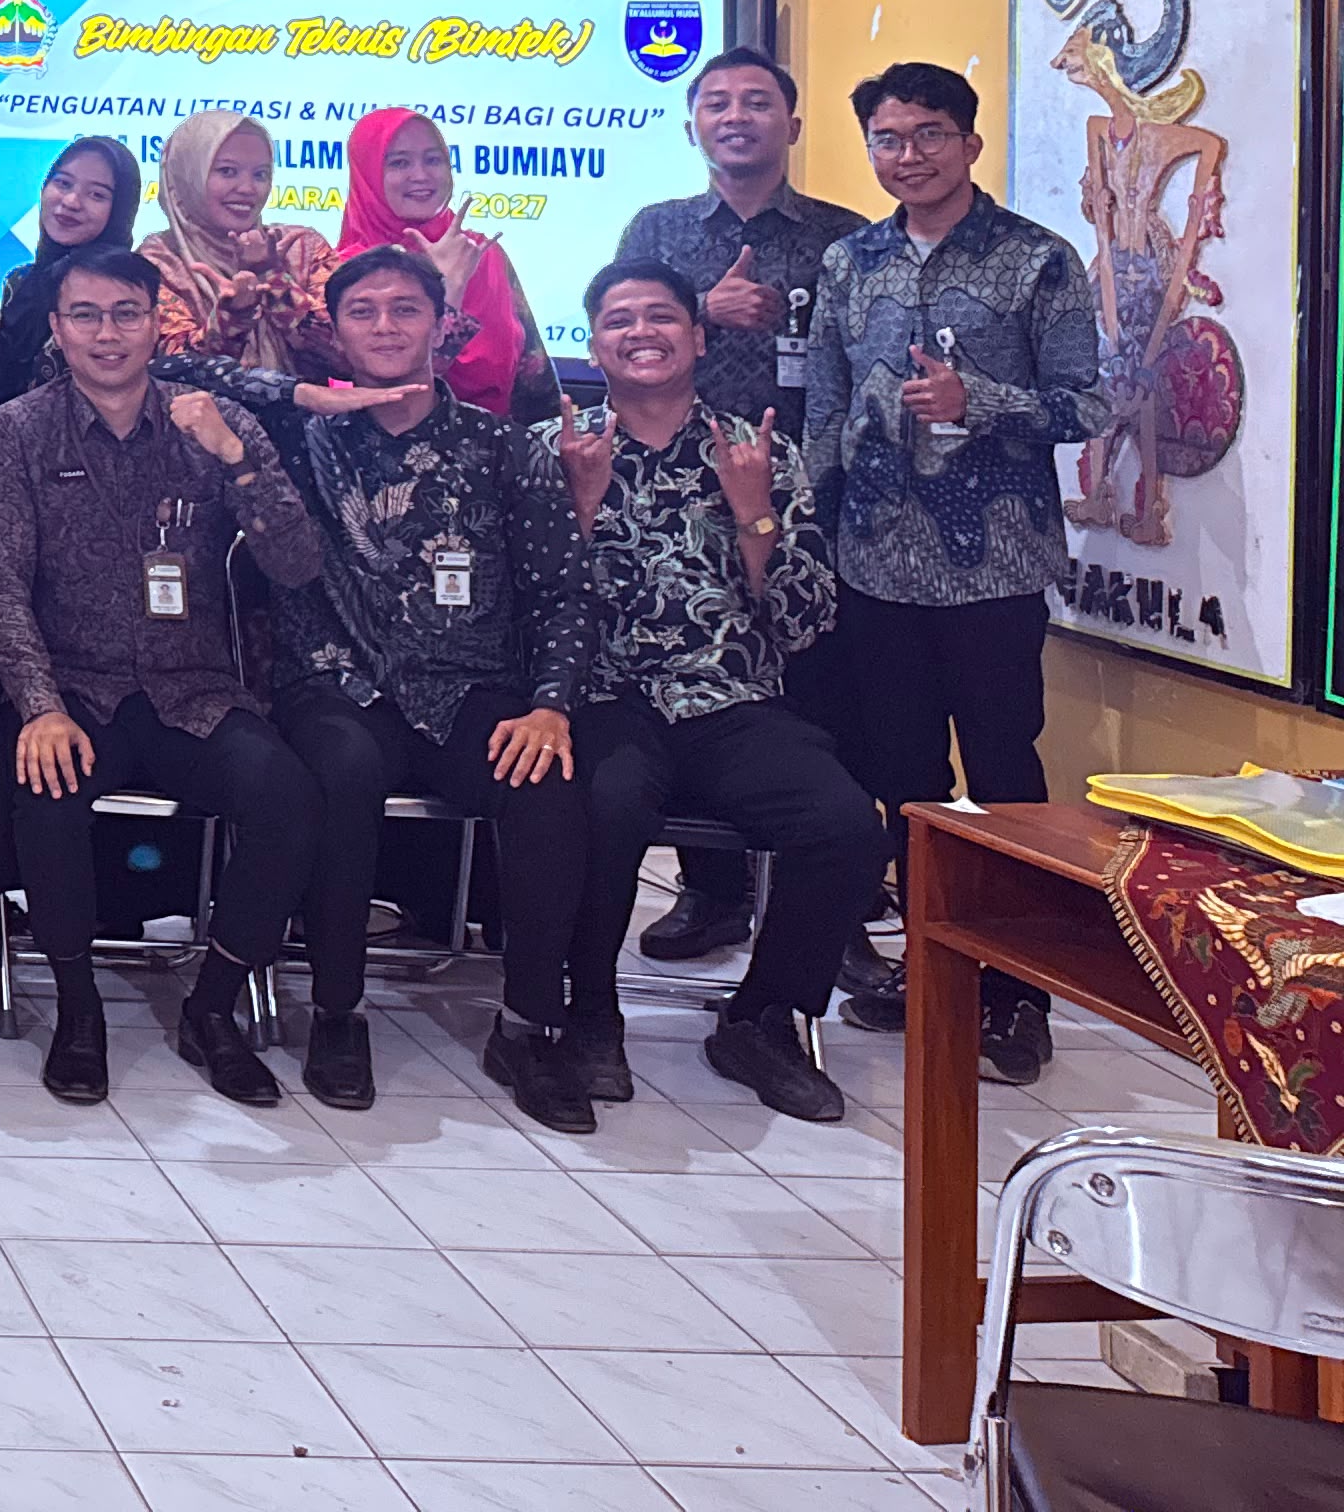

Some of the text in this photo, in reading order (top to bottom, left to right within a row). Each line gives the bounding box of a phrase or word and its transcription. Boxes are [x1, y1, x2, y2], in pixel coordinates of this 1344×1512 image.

[74, 13, 281, 64] Bimbingan
[285, 16, 409, 59] Teknis
[407, 17, 596, 66] (Bimtek)
[173, 98, 292, 120] LITERASI
[300, 101, 316, 121] &
[325, 102, 476, 125] NURASI
[483, 106, 554, 127] BAGI
[562, 107, 665, 130] GURU”
[474, 145, 606, 178] BUMIAYU
[545, 325, 566, 342] 17
